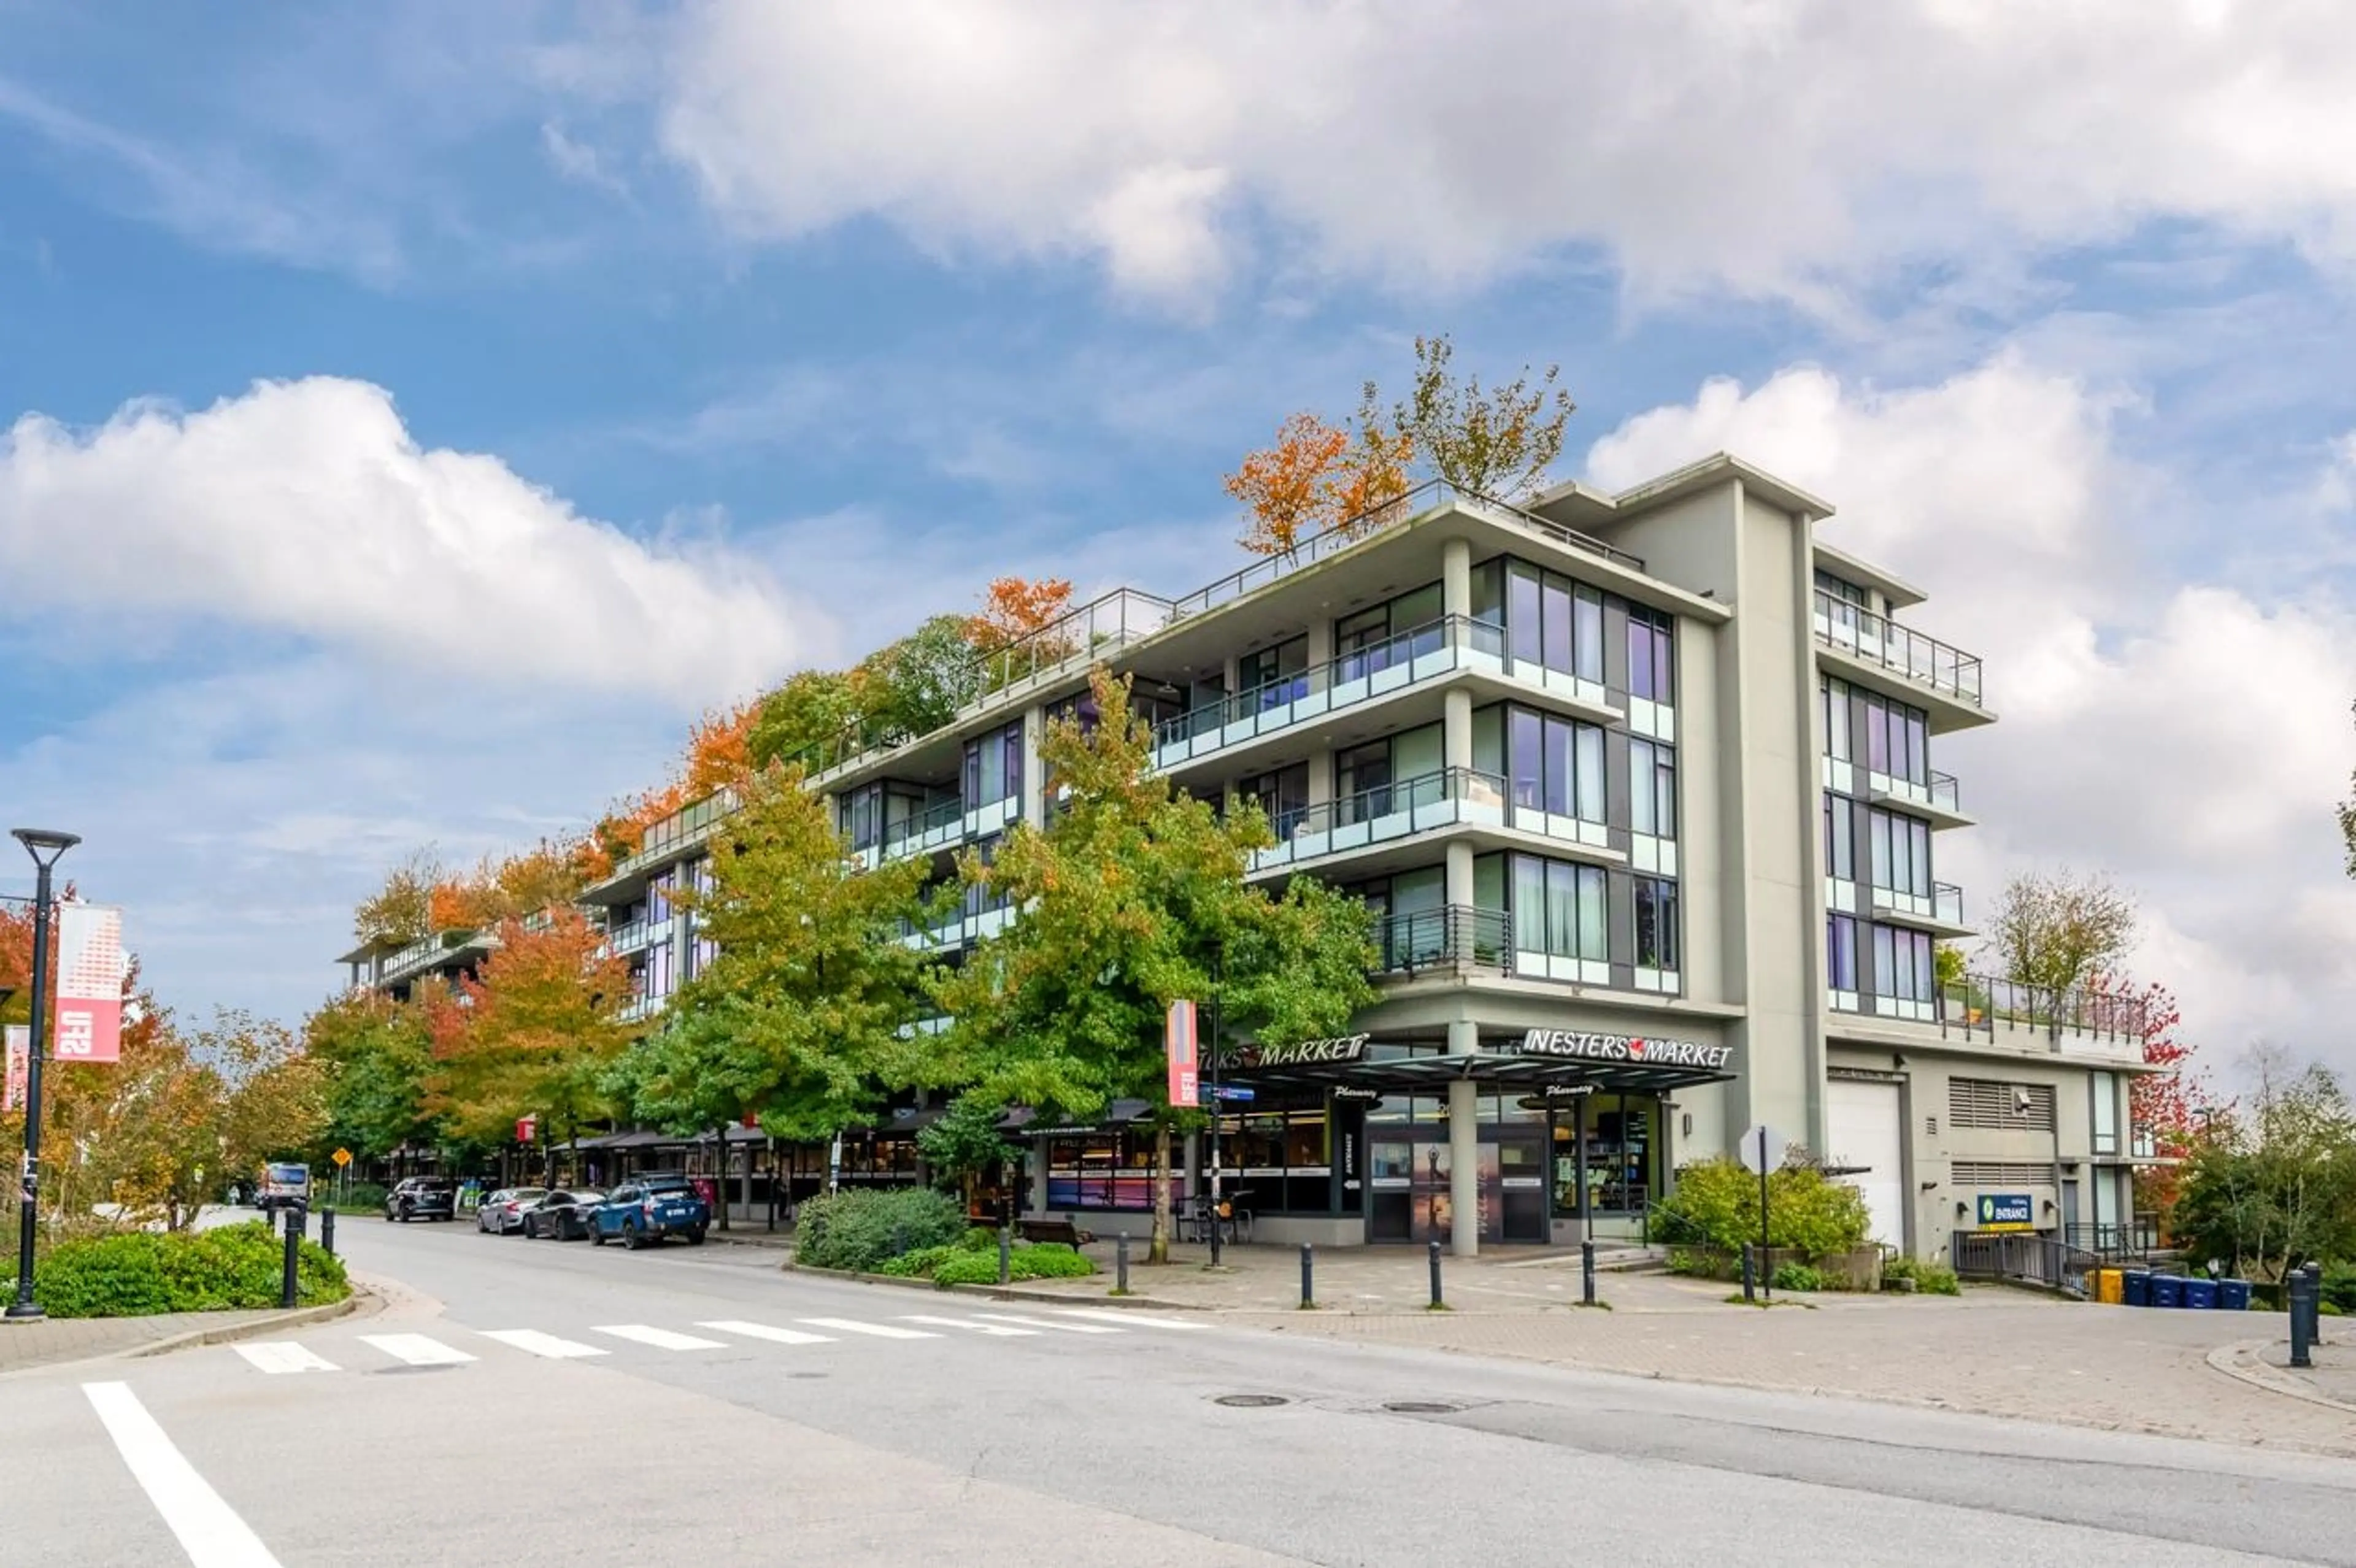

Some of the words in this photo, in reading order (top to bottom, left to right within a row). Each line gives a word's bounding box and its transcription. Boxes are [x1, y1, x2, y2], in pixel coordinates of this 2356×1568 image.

[1258, 1033, 1371, 1066] MARKET
[1523, 1029, 1628, 1059] NESTERS
[1643, 1039, 1733, 1067] MARKET
[1181, 1072, 1197, 1101] SFU
[1334, 1085, 1377, 1100] Pharmacy
[1546, 1085, 1593, 1097] Pharmacy
[1995, 1208, 2028, 1220] ENTRANCE
